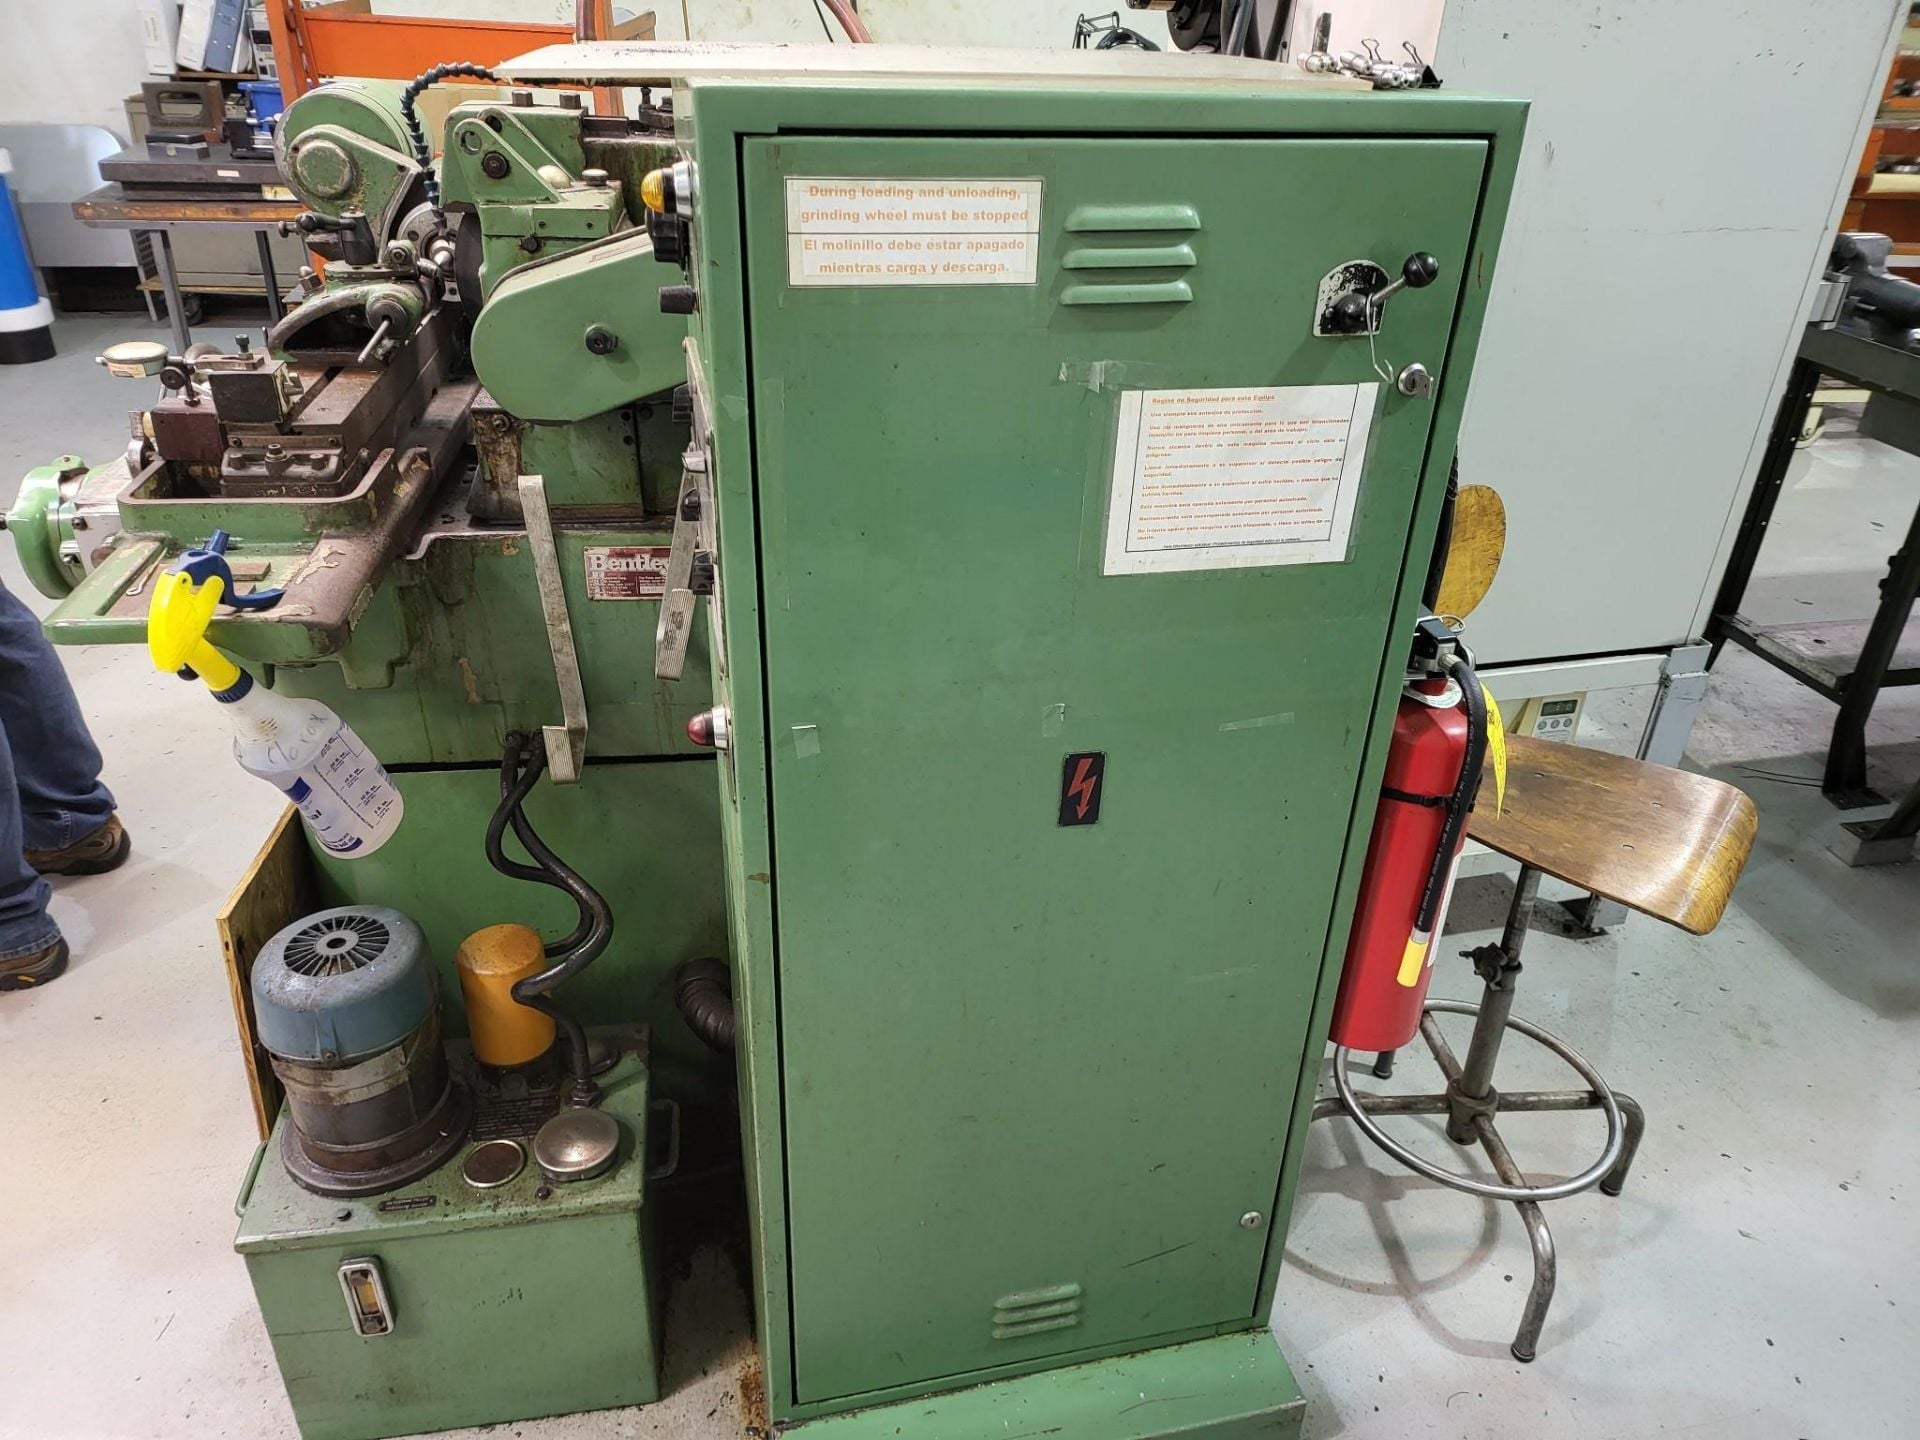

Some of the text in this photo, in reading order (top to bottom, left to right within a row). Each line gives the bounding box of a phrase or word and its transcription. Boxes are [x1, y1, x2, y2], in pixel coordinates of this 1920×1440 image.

[810, 185, 1020, 200] During loading and unloading,
[801, 209, 1028, 223] grinding wheel must be stopped
[804, 240, 1025, 252] El molinillo debe estar apagado
[819, 262, 1009, 275] mientras carga y descarga.
[590, 554, 669, 574] Bentley
